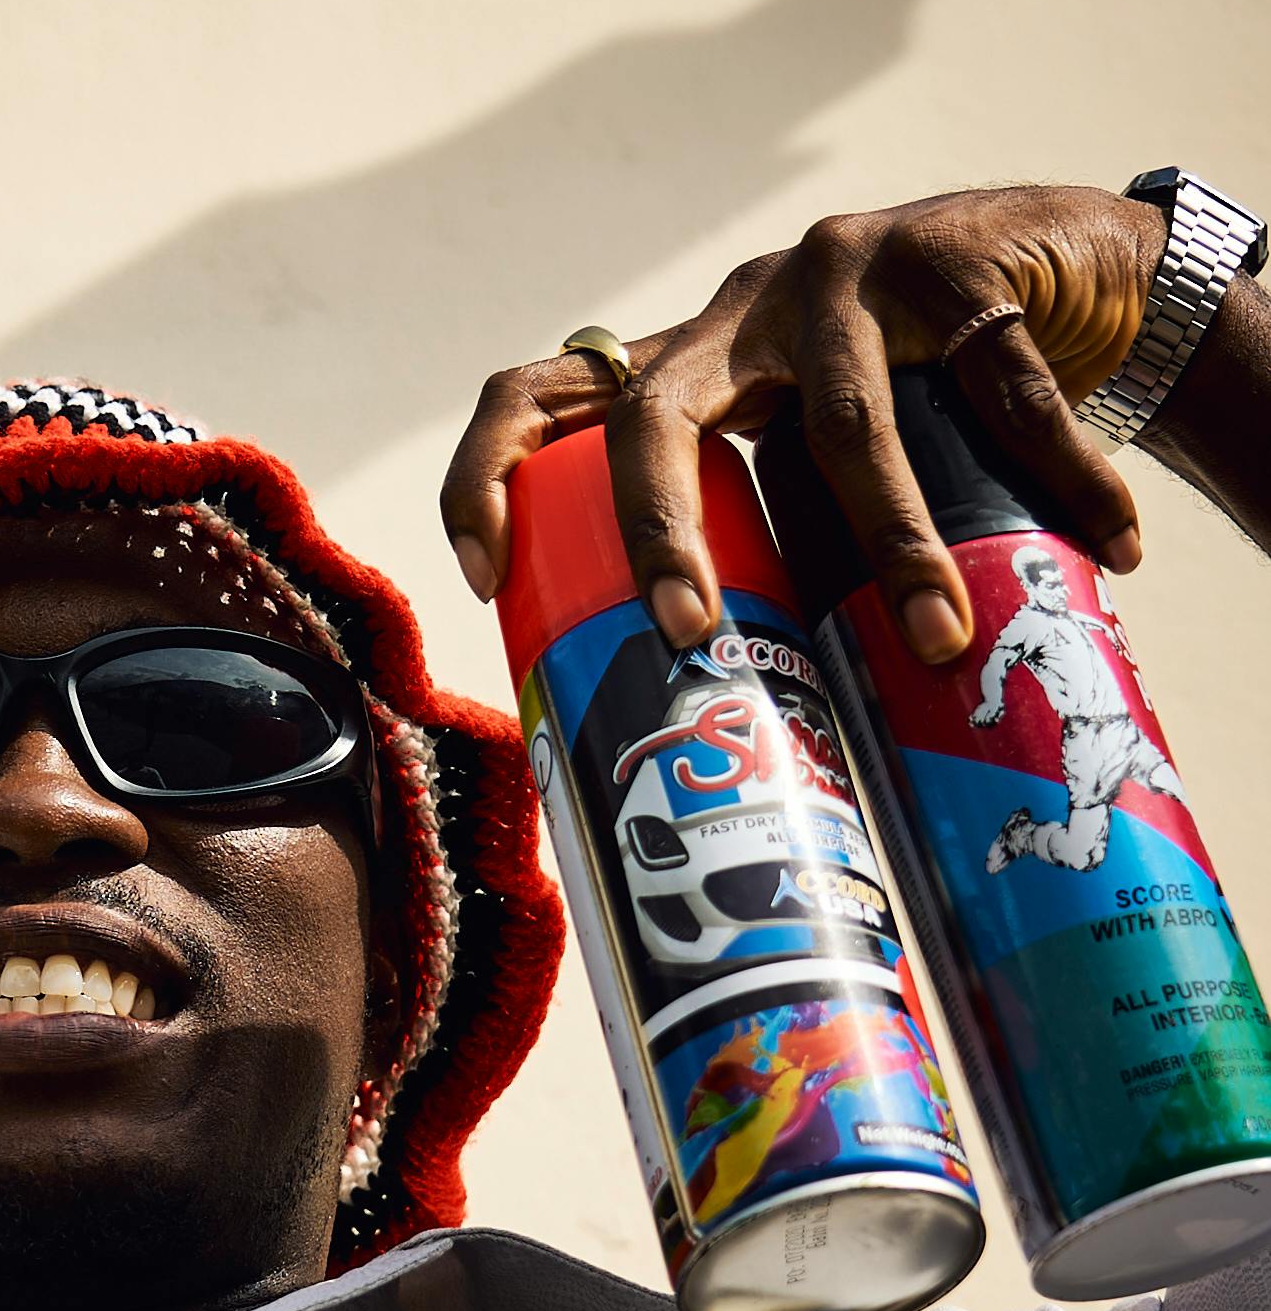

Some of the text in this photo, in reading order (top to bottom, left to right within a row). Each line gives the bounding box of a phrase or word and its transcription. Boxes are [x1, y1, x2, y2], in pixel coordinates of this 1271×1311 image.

[700, 819, 739, 838] FAST
[745, 816, 777, 829] DRY
[767, 832, 793, 843] ALL
[770, 868, 887, 913] ACCORD
[1115, 883, 1195, 908] SCORE
[817, 893, 882, 928] USA
[1091, 909, 1218, 941] WITH ABRO
[1112, 980, 1253, 1016] ALL PURPOSE
[1119, 1053, 1185, 1084] DANGER!
